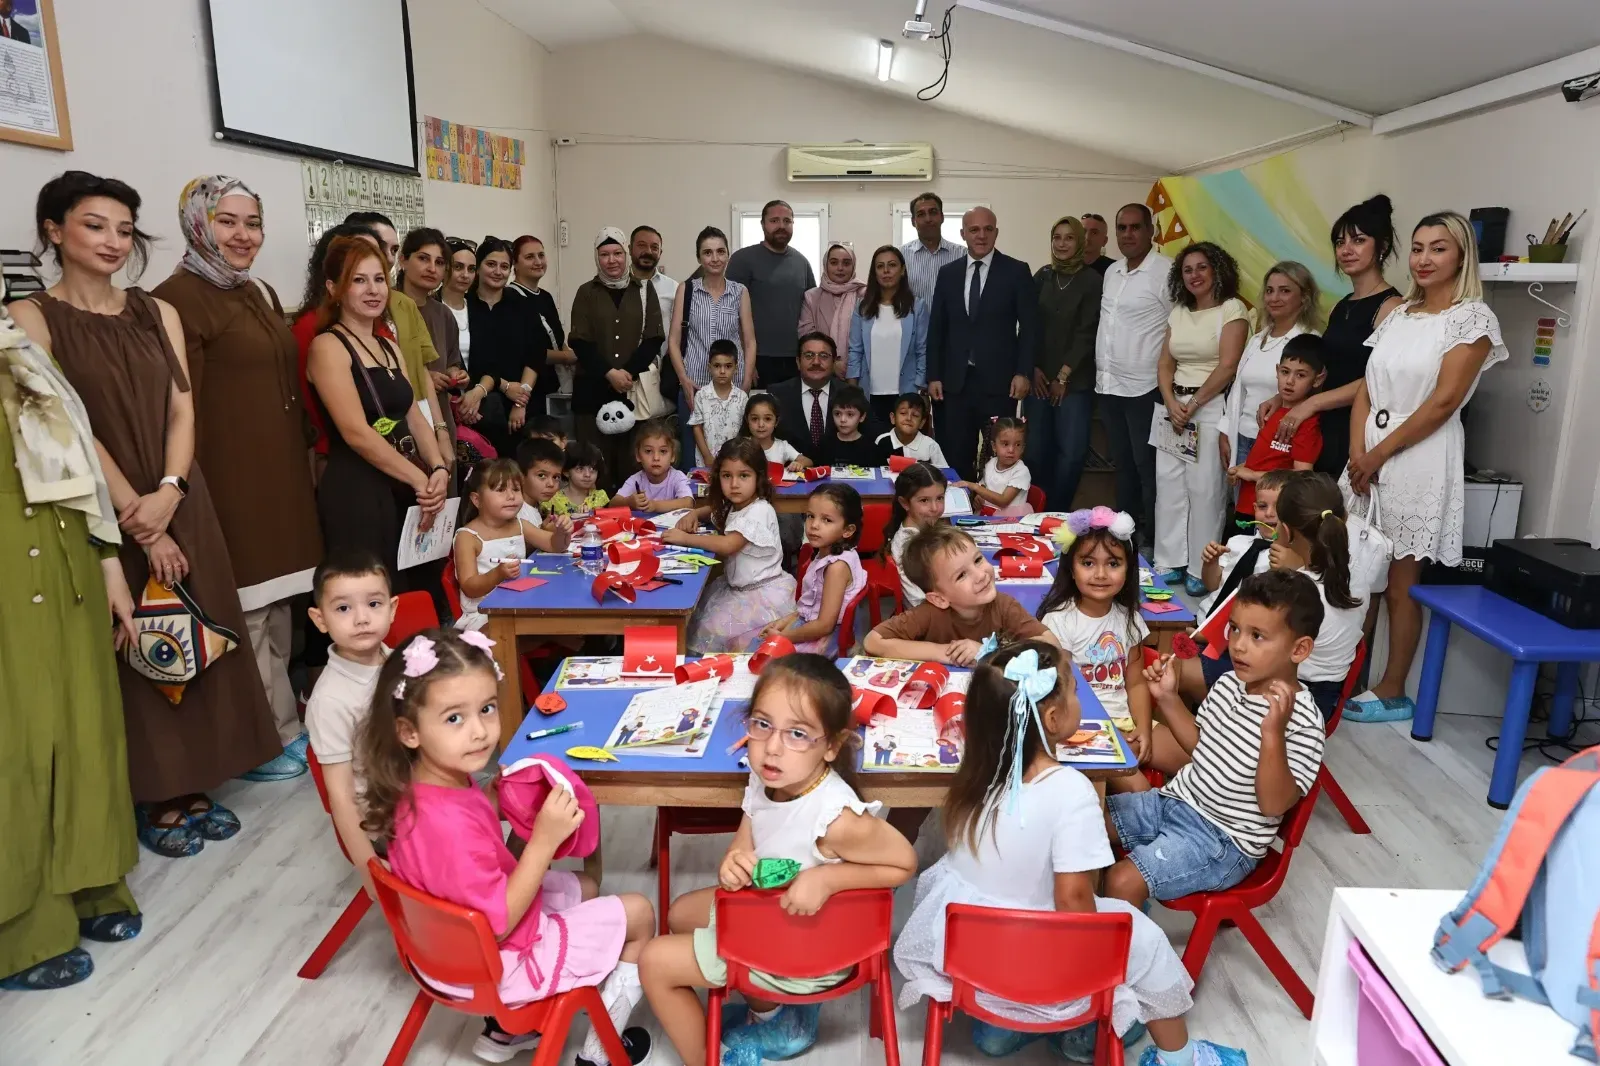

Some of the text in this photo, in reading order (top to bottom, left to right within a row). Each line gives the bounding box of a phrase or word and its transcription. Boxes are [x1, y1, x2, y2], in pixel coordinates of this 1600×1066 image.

[307, 165, 313, 183] 1
[321, 168, 328, 186] 2
[349, 171, 355, 186] 4
[361, 175, 368, 192] 5
[373, 177, 379, 191] 6
[395, 180, 401, 194] 8
[406, 180, 411, 193] 9
